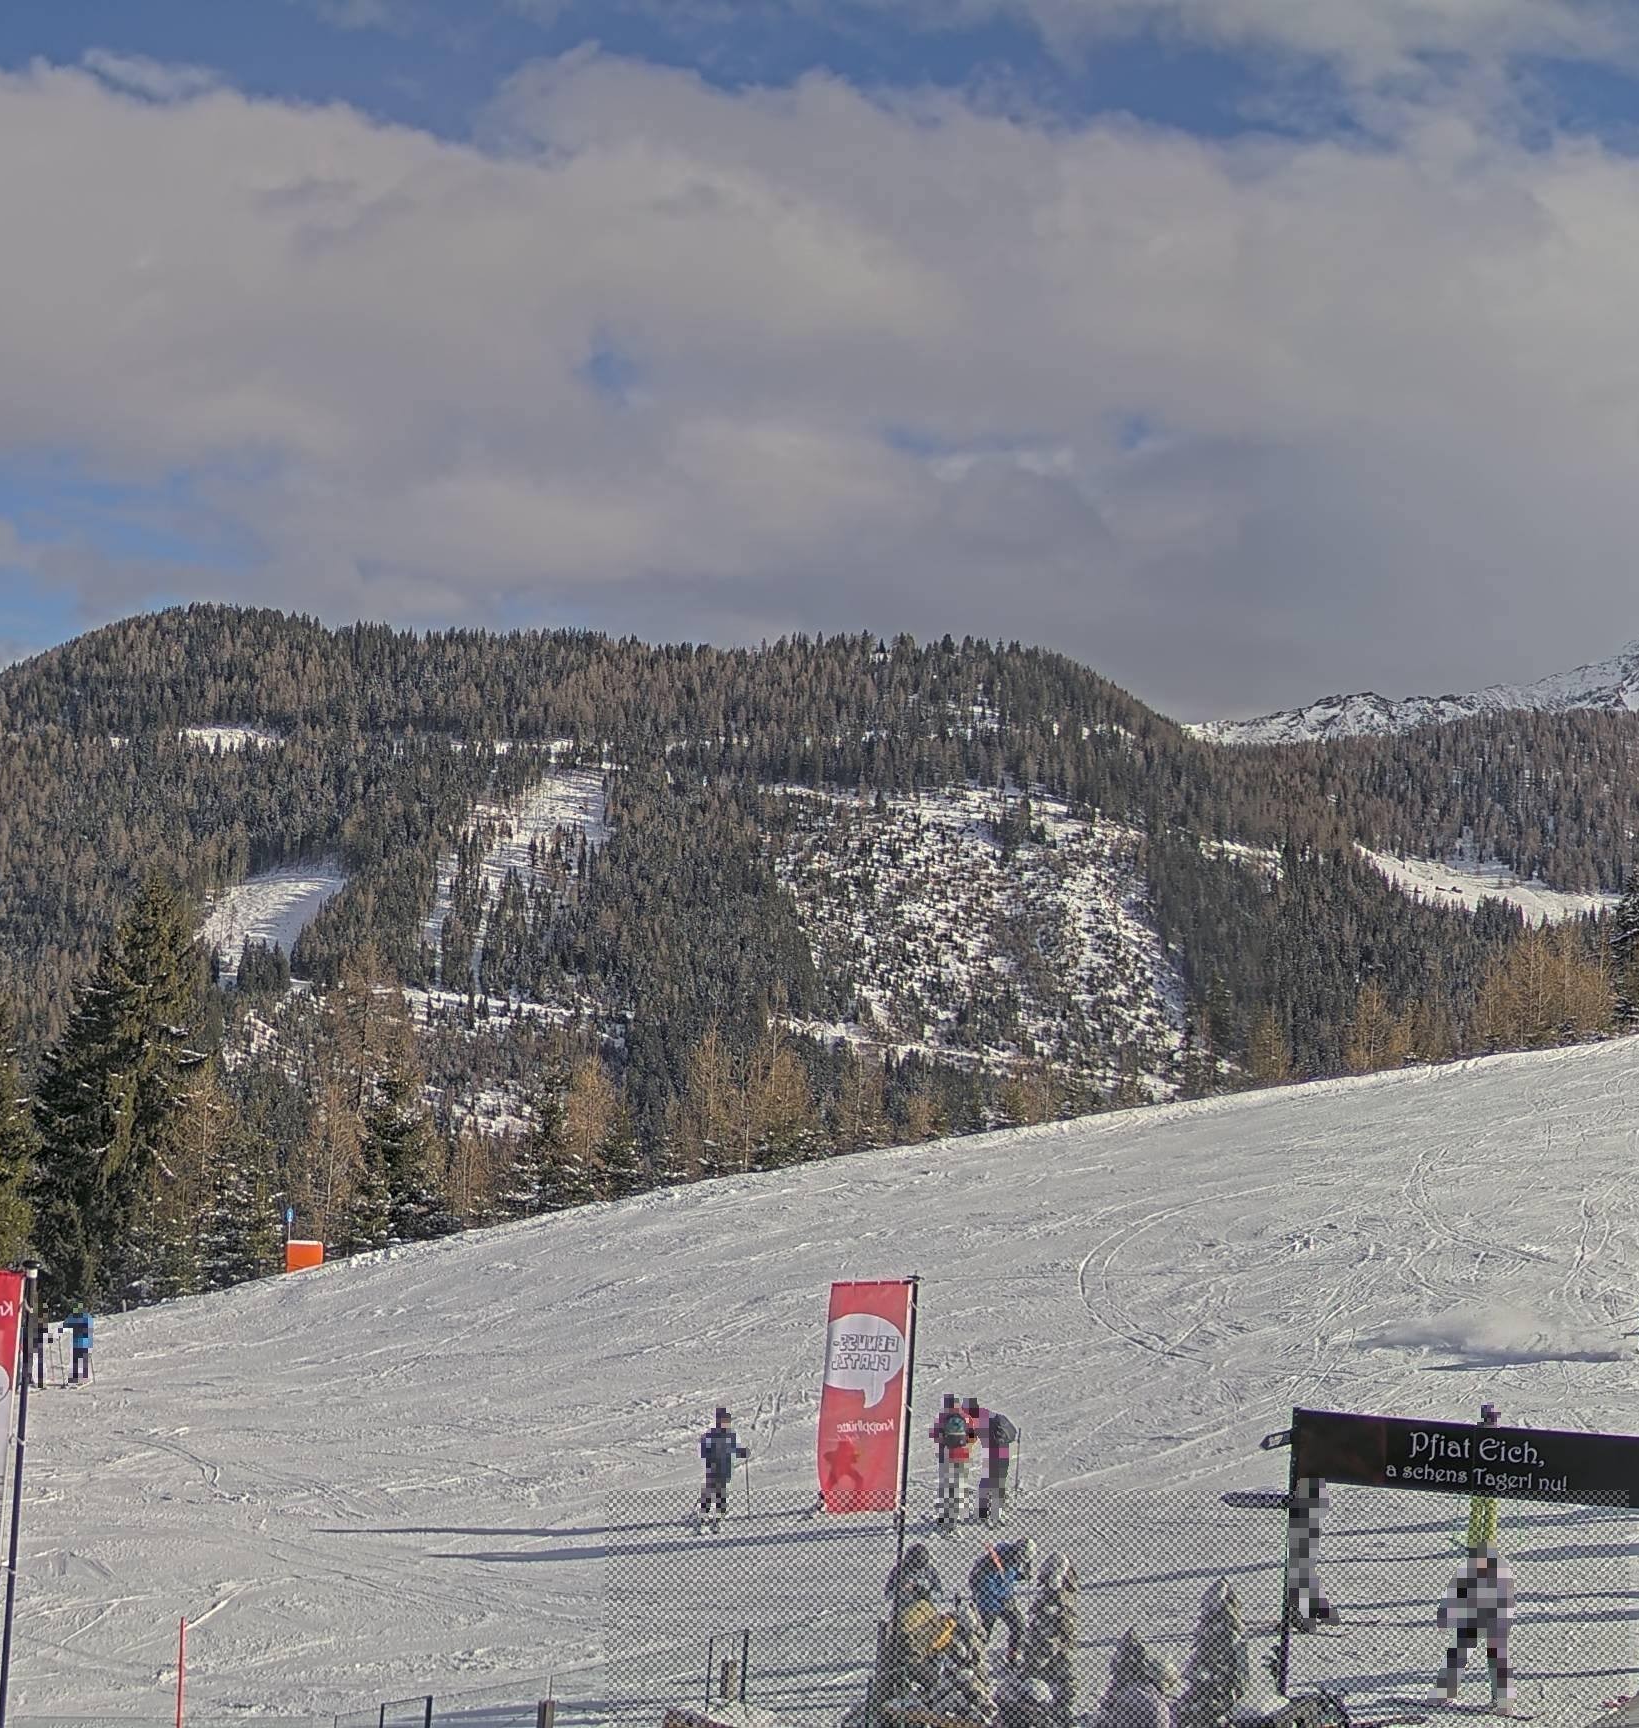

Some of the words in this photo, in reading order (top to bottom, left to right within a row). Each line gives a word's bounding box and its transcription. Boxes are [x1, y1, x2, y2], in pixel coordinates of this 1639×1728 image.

[1409, 1431, 1471, 1461] Pfiat
[1479, 1437, 1545, 1468] Eich,
[1385, 1465, 1397, 1478] a
[1402, 1463, 1468, 1484] schens
[1473, 1468, 1533, 1491] Tagerl
[1538, 1475, 1567, 1492] nu!
